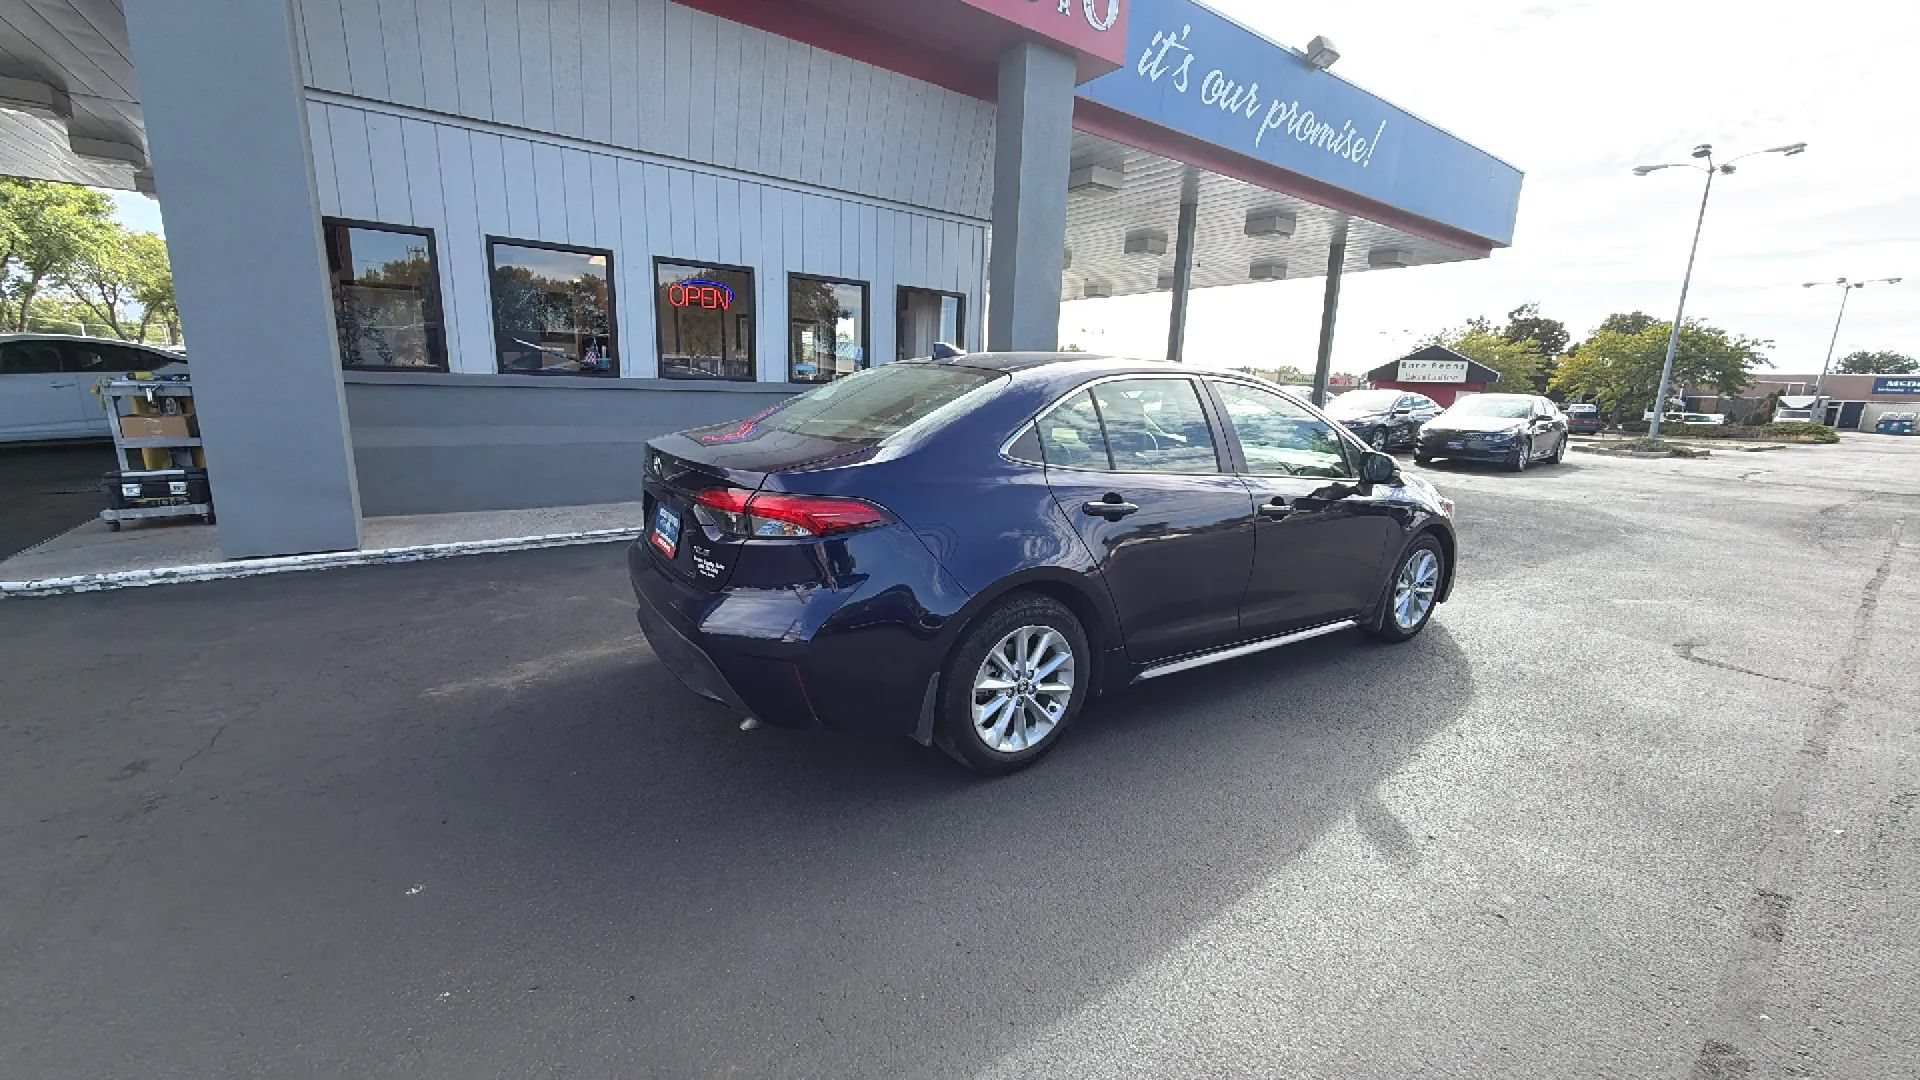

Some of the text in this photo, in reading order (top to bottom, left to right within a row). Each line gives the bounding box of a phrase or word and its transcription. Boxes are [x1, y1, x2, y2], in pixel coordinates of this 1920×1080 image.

[1138, 24, 1387, 168] it's our promise!
[669, 284, 729, 311] OPEN
